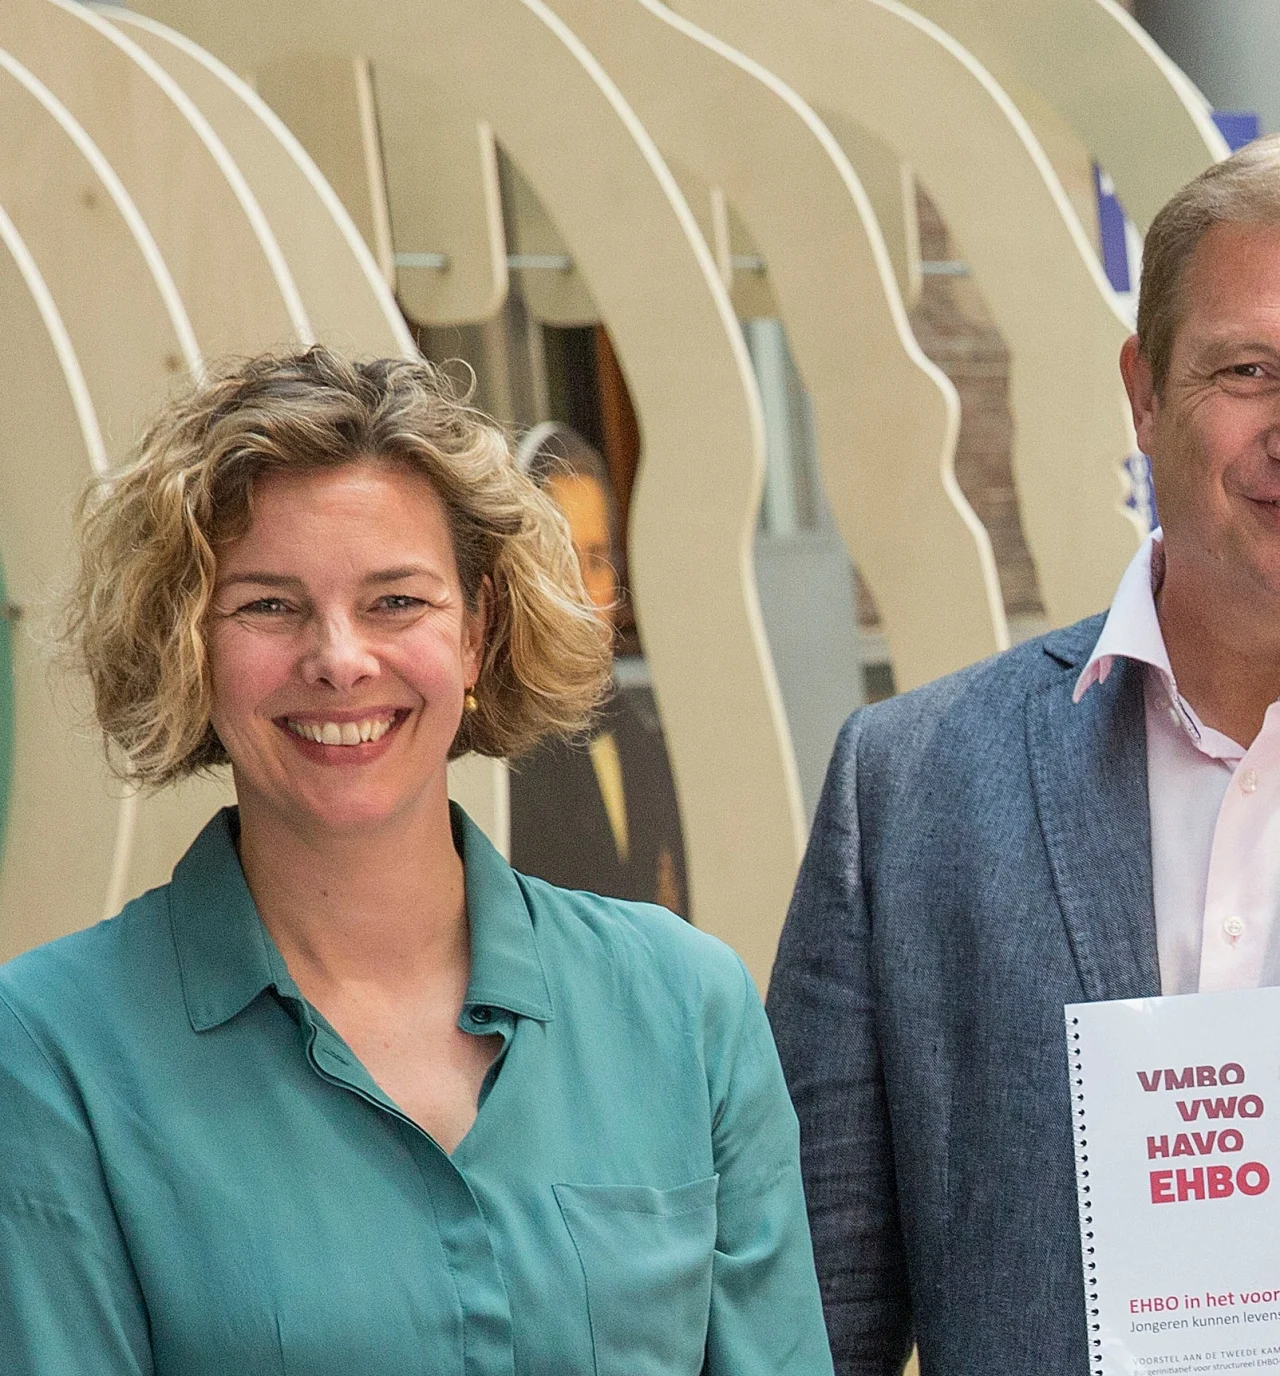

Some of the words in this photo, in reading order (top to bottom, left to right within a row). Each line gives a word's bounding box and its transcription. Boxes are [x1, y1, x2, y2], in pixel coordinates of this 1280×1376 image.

[1136, 1062, 1246, 1092] VMBO
[1176, 1095, 1264, 1122] VWO
[1147, 1129, 1244, 1159] HAVO
[1149, 1161, 1270, 1204] EHBO
[1129, 1296, 1179, 1314] EHBO
[1185, 1294, 1200, 1309] in
[1206, 1291, 1234, 1307] het
[1130, 1317, 1188, 1334] Jongeren
[1192, 1313, 1240, 1327] kunnen
[1183, 1353, 1202, 1362] AAN
[1205, 1351, 1217, 1360] DE
[1221, 1348, 1258, 1359] TWEEDE
